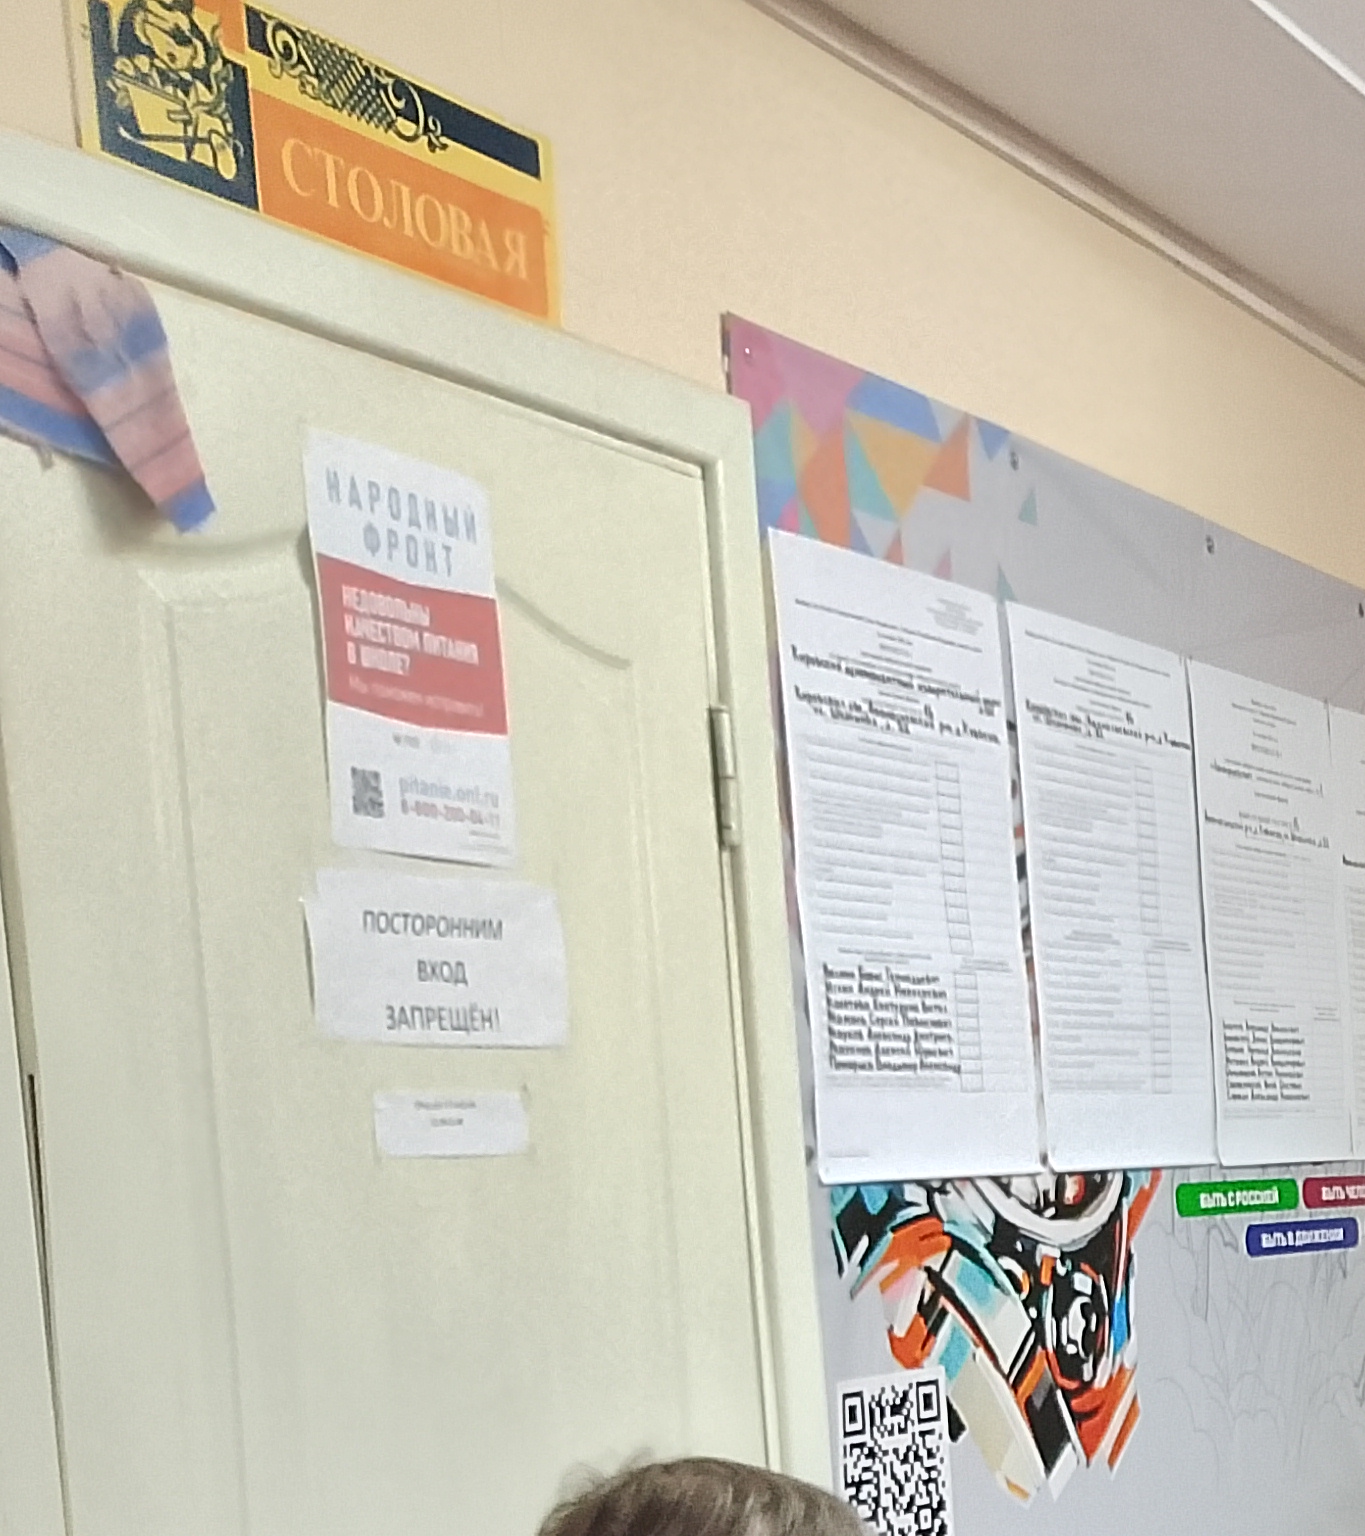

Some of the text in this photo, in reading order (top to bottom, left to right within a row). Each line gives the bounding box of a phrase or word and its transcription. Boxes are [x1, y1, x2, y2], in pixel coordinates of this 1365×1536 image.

[281, 137, 528, 280] СТОЛОВАЯ
[325, 467, 477, 544] НАРОДНЫЙ
[363, 521, 452, 577] ФРОНТ
[362, 909, 503, 941] ПОСТОРОННИМ
[417, 958, 468, 987] ВХОД
[385, 1002, 502, 1036] ЗАПРЕЩЁН!
[1200, 1192, 1227, 1209] БЫТЬ
